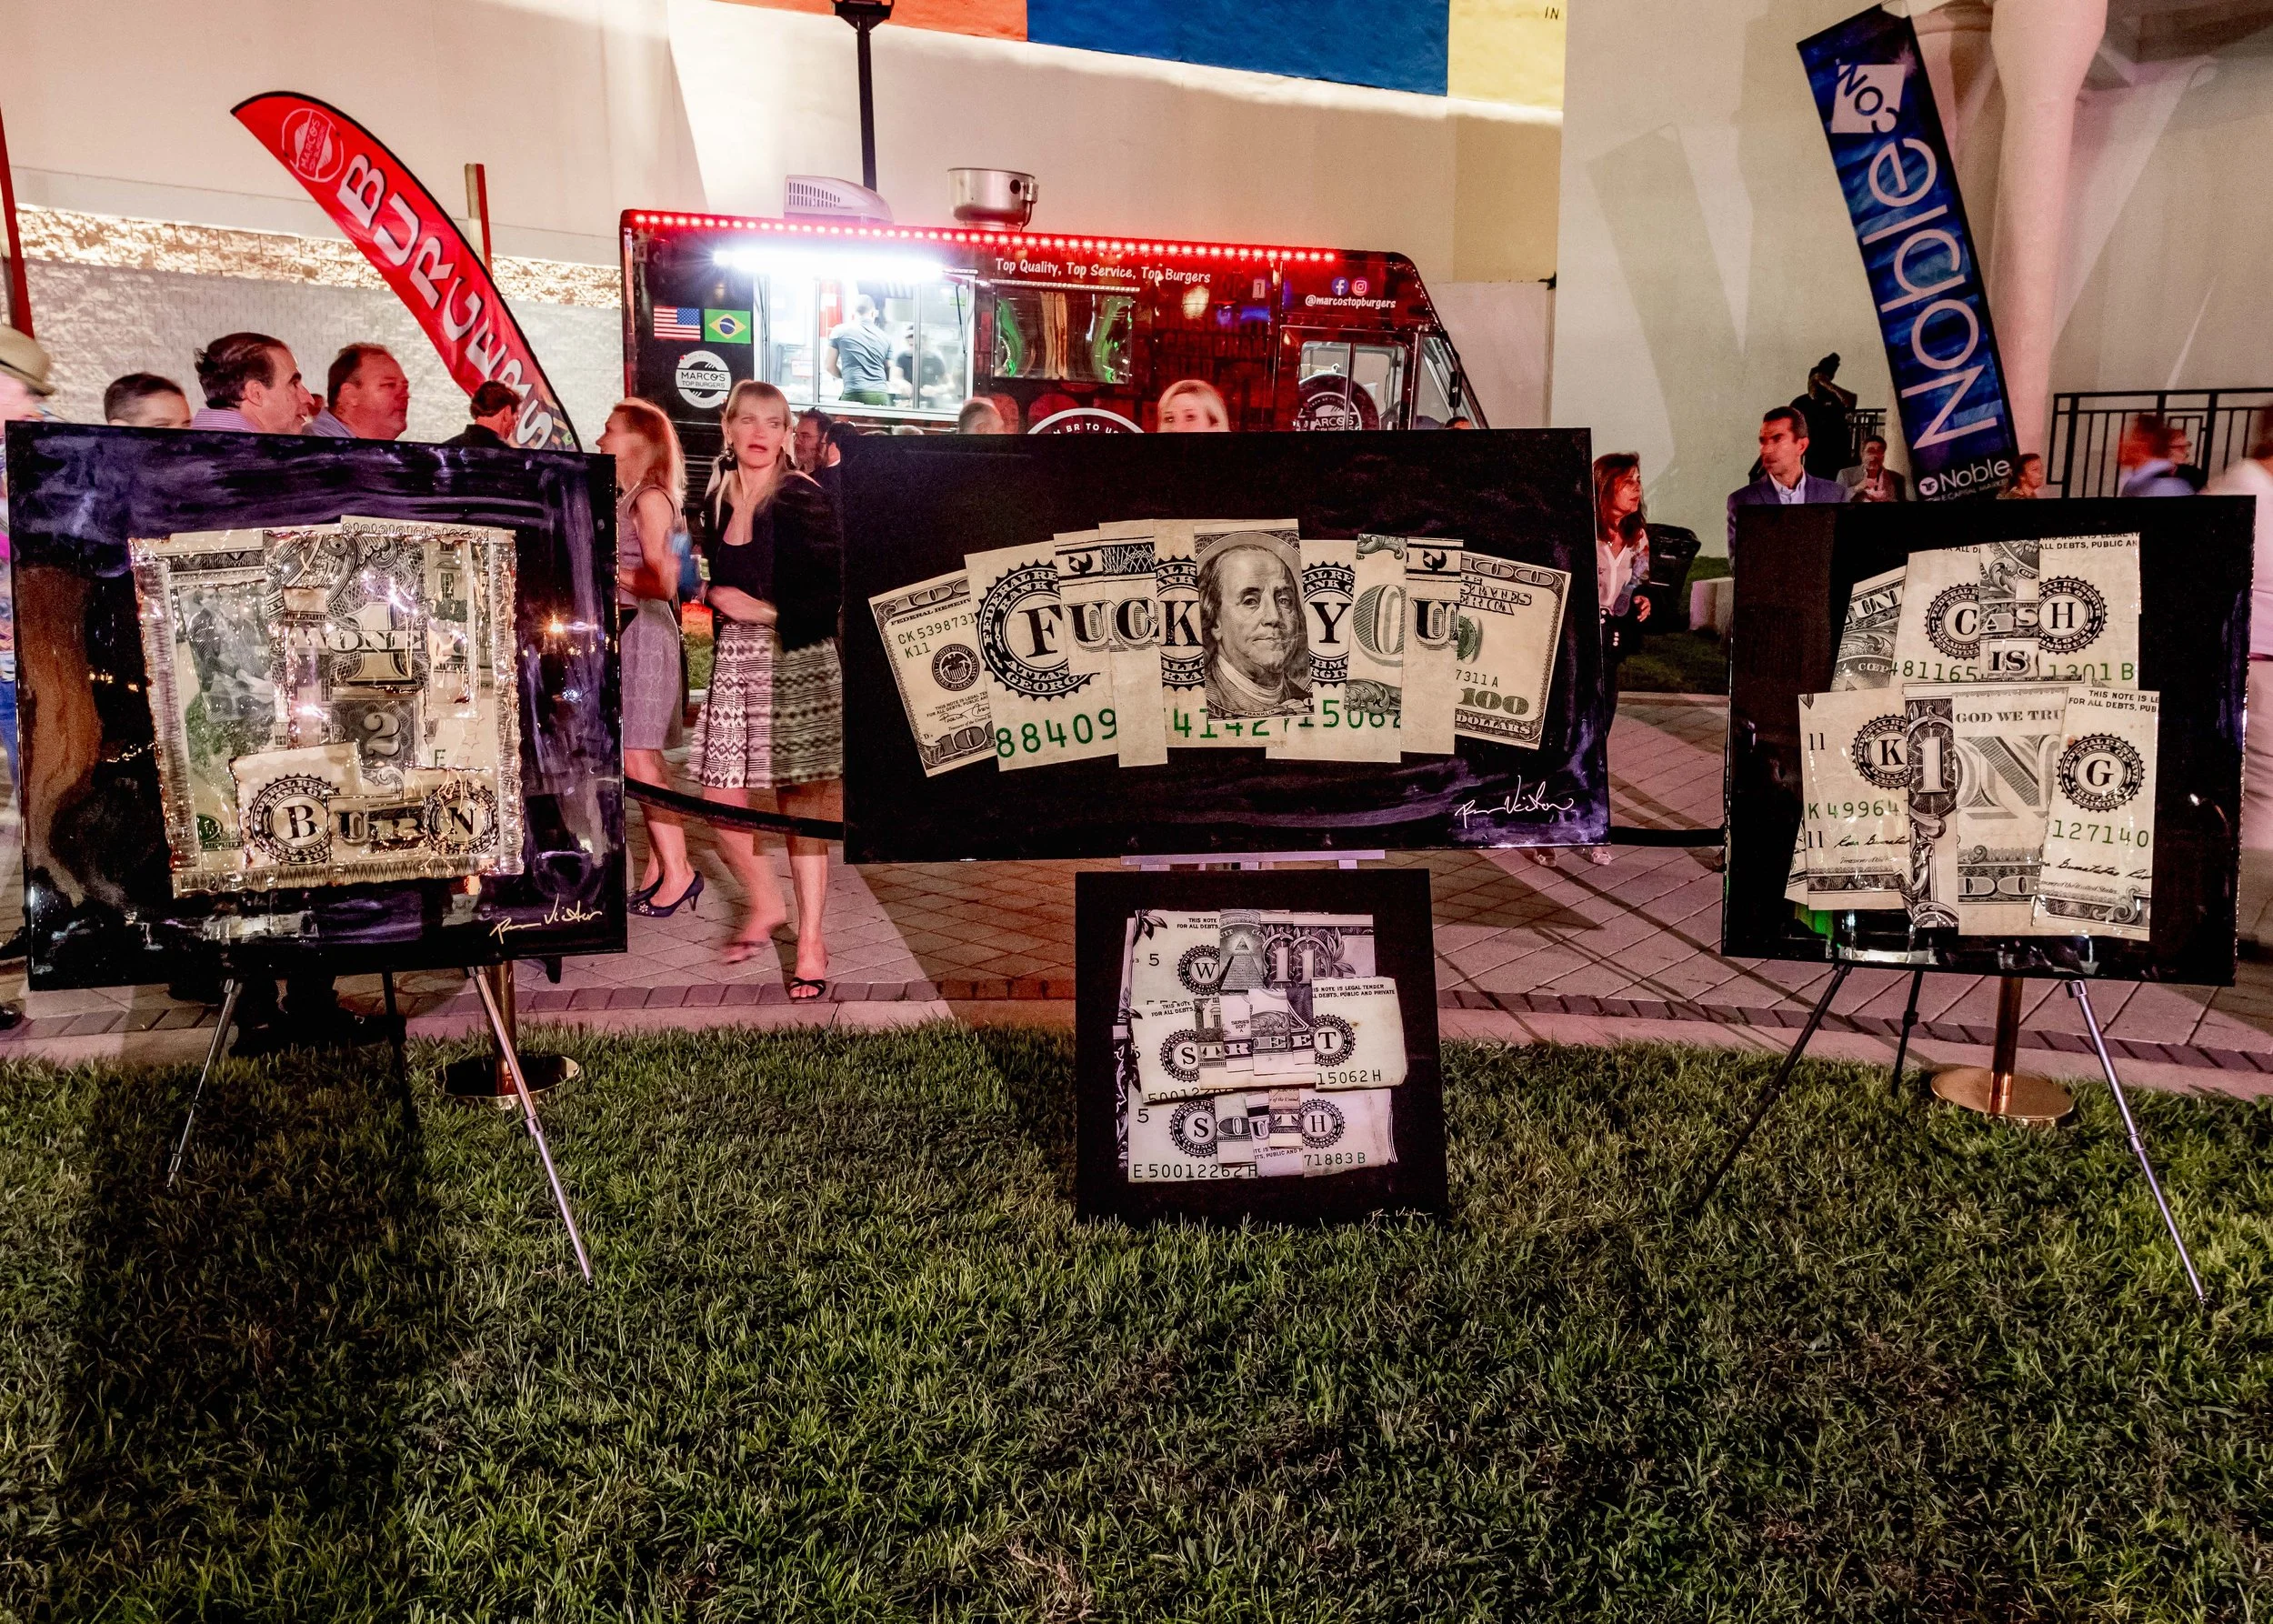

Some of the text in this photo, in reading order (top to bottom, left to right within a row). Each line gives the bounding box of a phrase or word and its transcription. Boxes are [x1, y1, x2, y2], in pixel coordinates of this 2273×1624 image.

[1544, 5, 1559, 20] IN
[996, 257, 1211, 285] Top Quality, Top Service, Top Burgers
[335, 154, 554, 449] BURGERS
[1305, 294, 1397, 310] @marcostopburgers
[1863, 138, 1998, 450] Noble
[681, 371, 726, 382] MARCOS
[1085, 423, 1100, 431] TO
[1939, 458, 2011, 492] Noble
[2057, 542, 2089, 550] DEBTS,
[2091, 540, 2123, 548] PUBLIC
[996, 581, 1049, 615] BANK
[1459, 583, 1532, 606] STATES
[890, 609, 934, 627] FEDERAL
[1309, 585, 1459, 657] YOU
[1016, 596, 1204, 658] FUCK
[1989, 649, 2031, 677] IS
[2121, 662, 2135, 681] B
[1457, 687, 1529, 716] 100
[2089, 690, 2108, 698] THIS
[2111, 692, 2134, 701] NOTE
[2087, 699, 2104, 707] ALL
[2106, 701, 2138, 712] DEBTS,
[1956, 711, 1993, 723] GOD
[1996, 711, 2023, 722] WE
[995, 707, 1117, 758] 88409
[1457, 716, 1532, 736] DOLLARS
[1807, 802, 1820, 819] K
[2052, 819, 2149, 847] 127140
[1148, 953, 1160, 967] 5
[1317, 1068, 1382, 1085] 15062 H
[1136, 1108, 1149, 1124] 5
[1266, 1150, 1286, 1159] PUBLIC
[1304, 1151, 1366, 1167] 71883 B
[1134, 1163, 1143, 1178] E
[1148, 1163, 1243, 1179] 50012262
